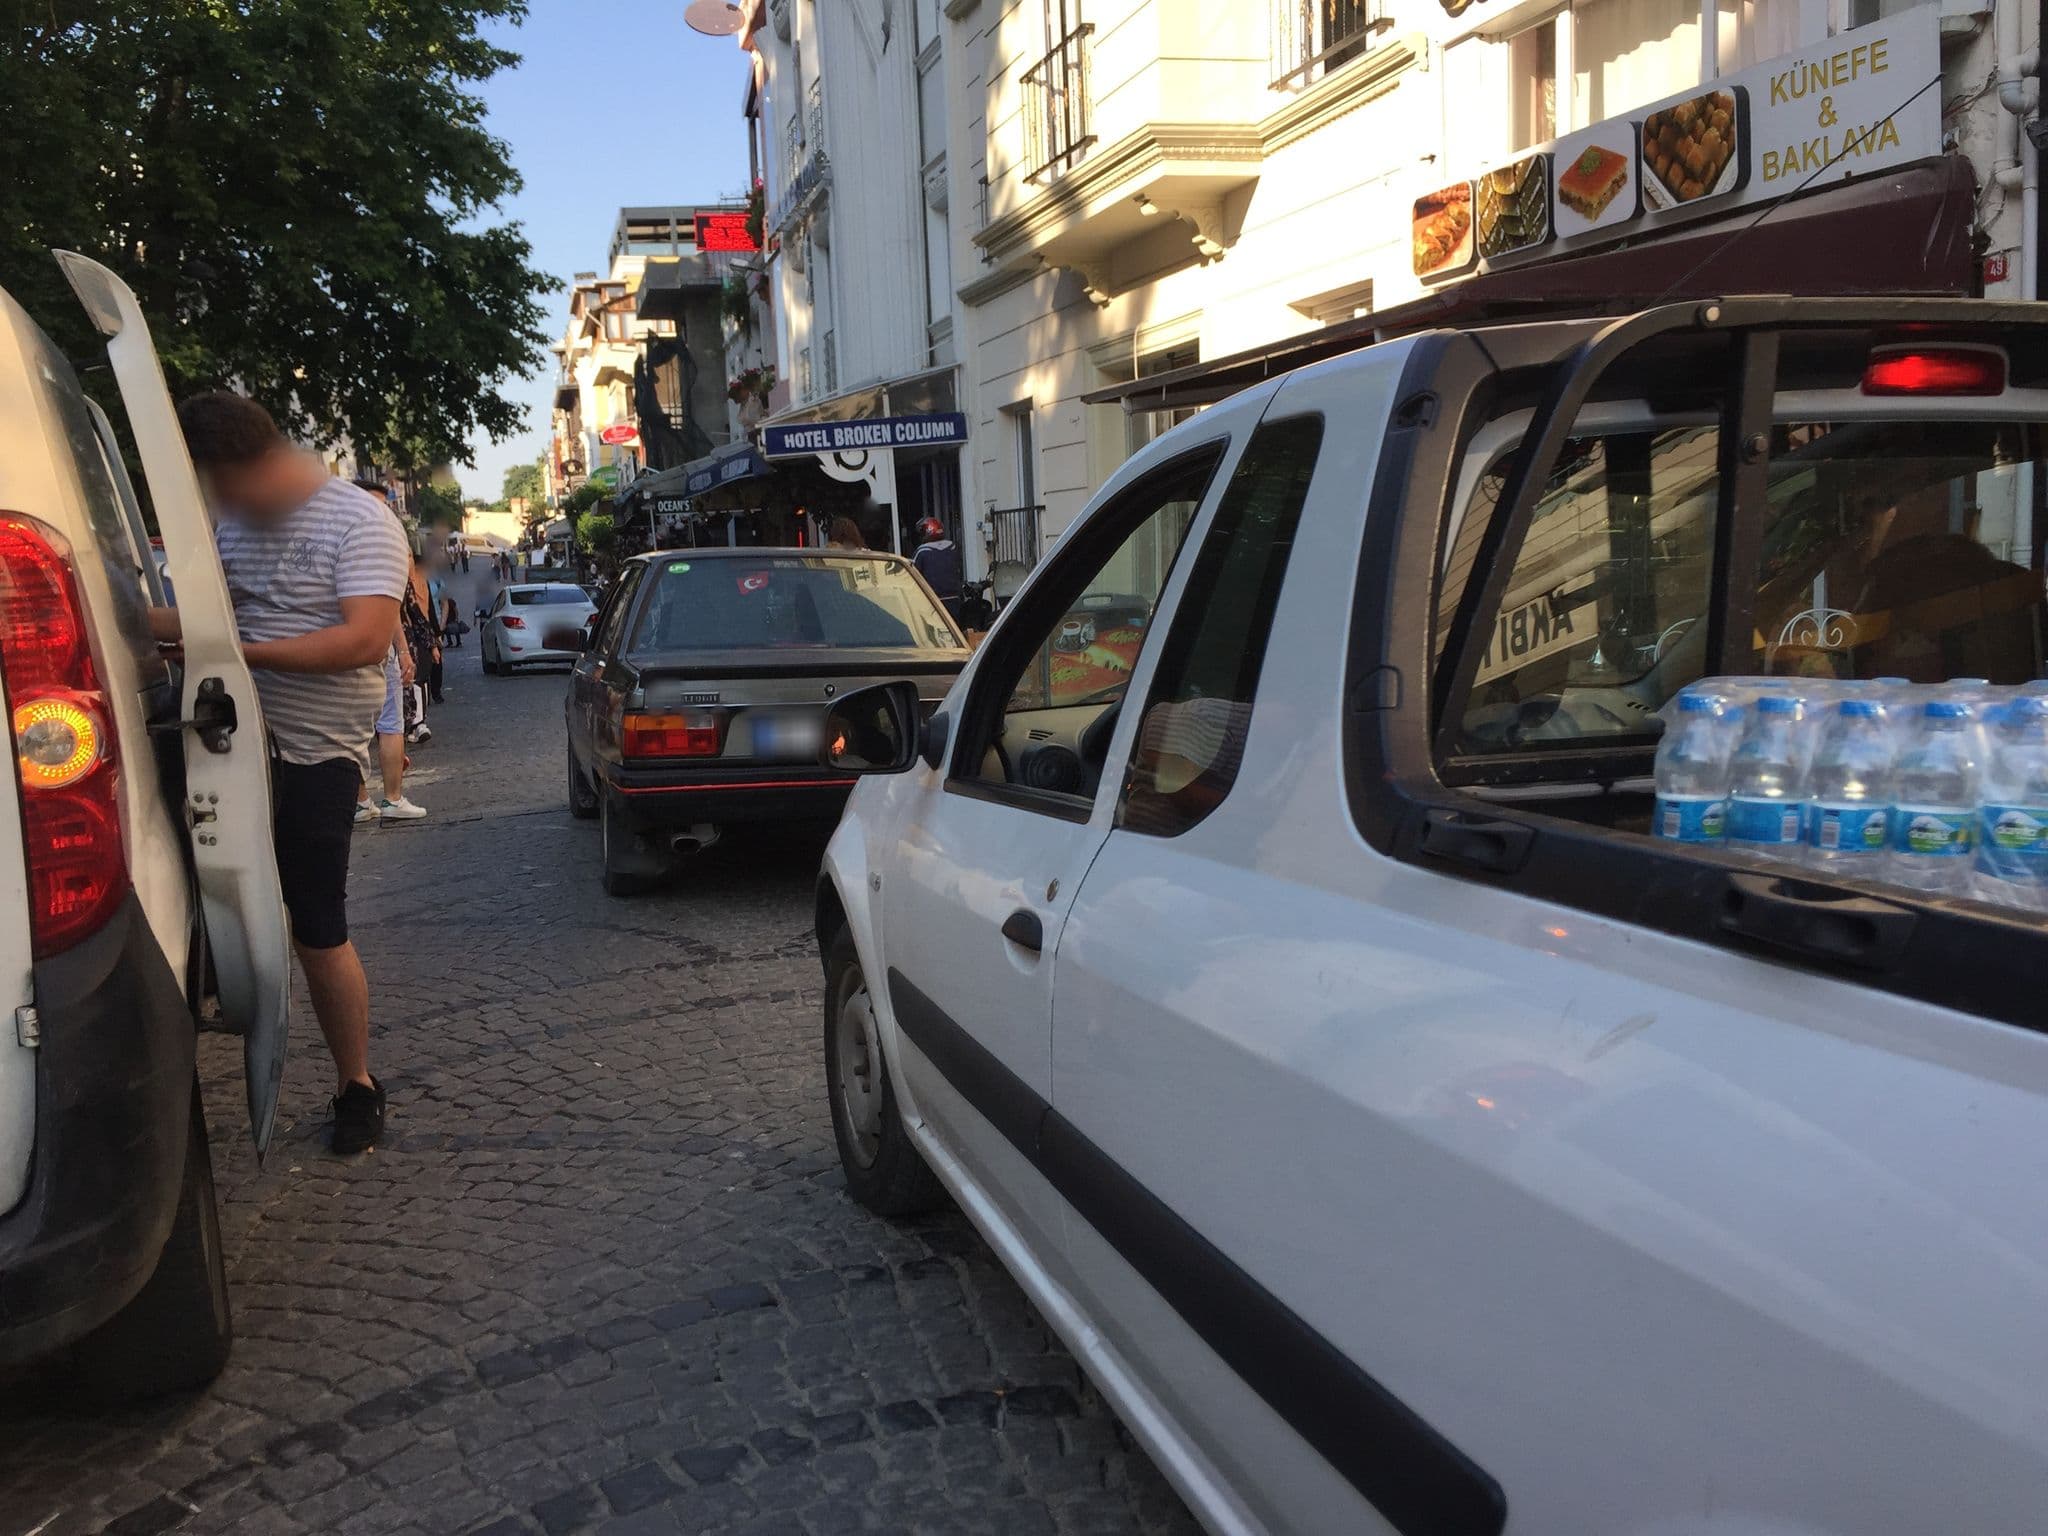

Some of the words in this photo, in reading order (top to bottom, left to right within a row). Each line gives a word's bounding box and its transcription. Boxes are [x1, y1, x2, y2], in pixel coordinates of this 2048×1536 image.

[1770, 38, 1889, 107] KÜNEFE
[1818, 96, 1838, 129] &
[1762, 117, 1901, 183] BAKLAVA
[784, 430, 831, 448] HOTEL
[834, 424, 892, 446] BROKEN
[895, 422, 955, 441] COLUMN
[657, 499, 690, 512] OCEAN'S
